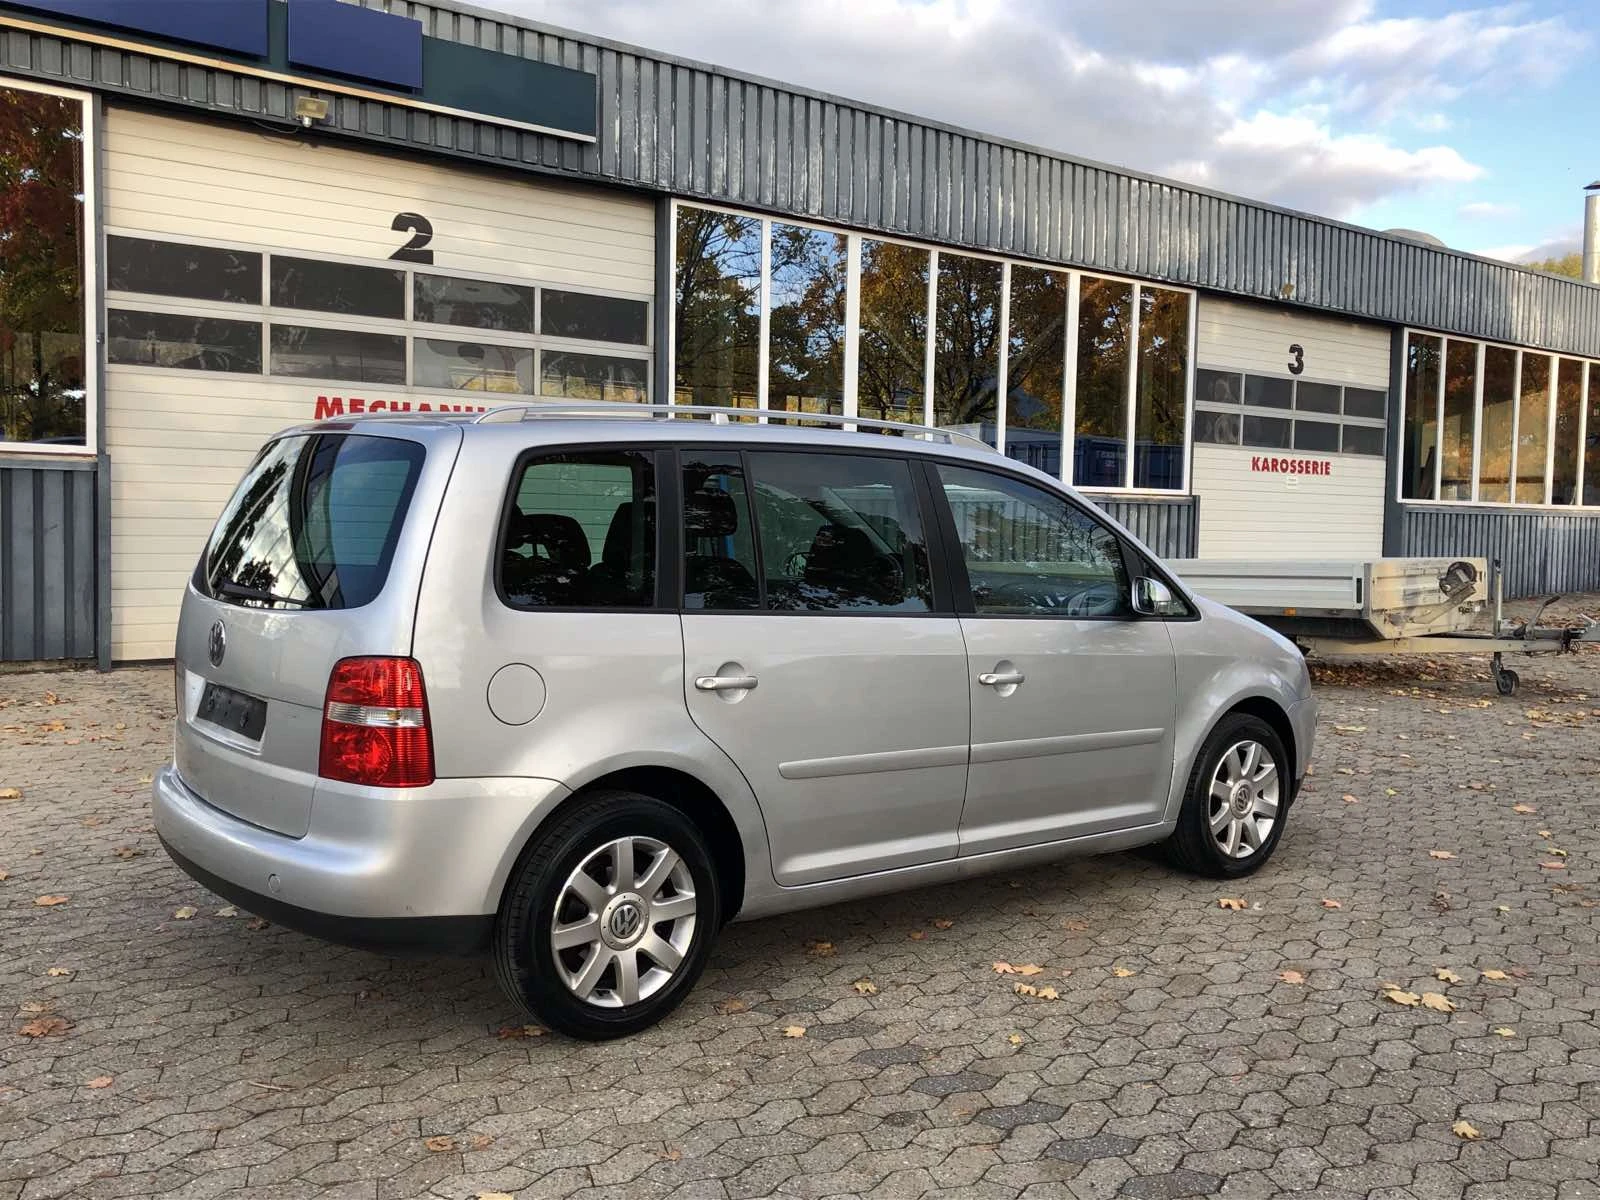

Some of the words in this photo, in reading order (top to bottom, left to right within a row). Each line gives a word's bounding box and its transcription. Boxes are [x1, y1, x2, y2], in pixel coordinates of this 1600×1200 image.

[388, 212, 434, 265] 2
[1287, 343, 1304, 375] 3
[1252, 456, 1331, 476] KAROSSERIE
